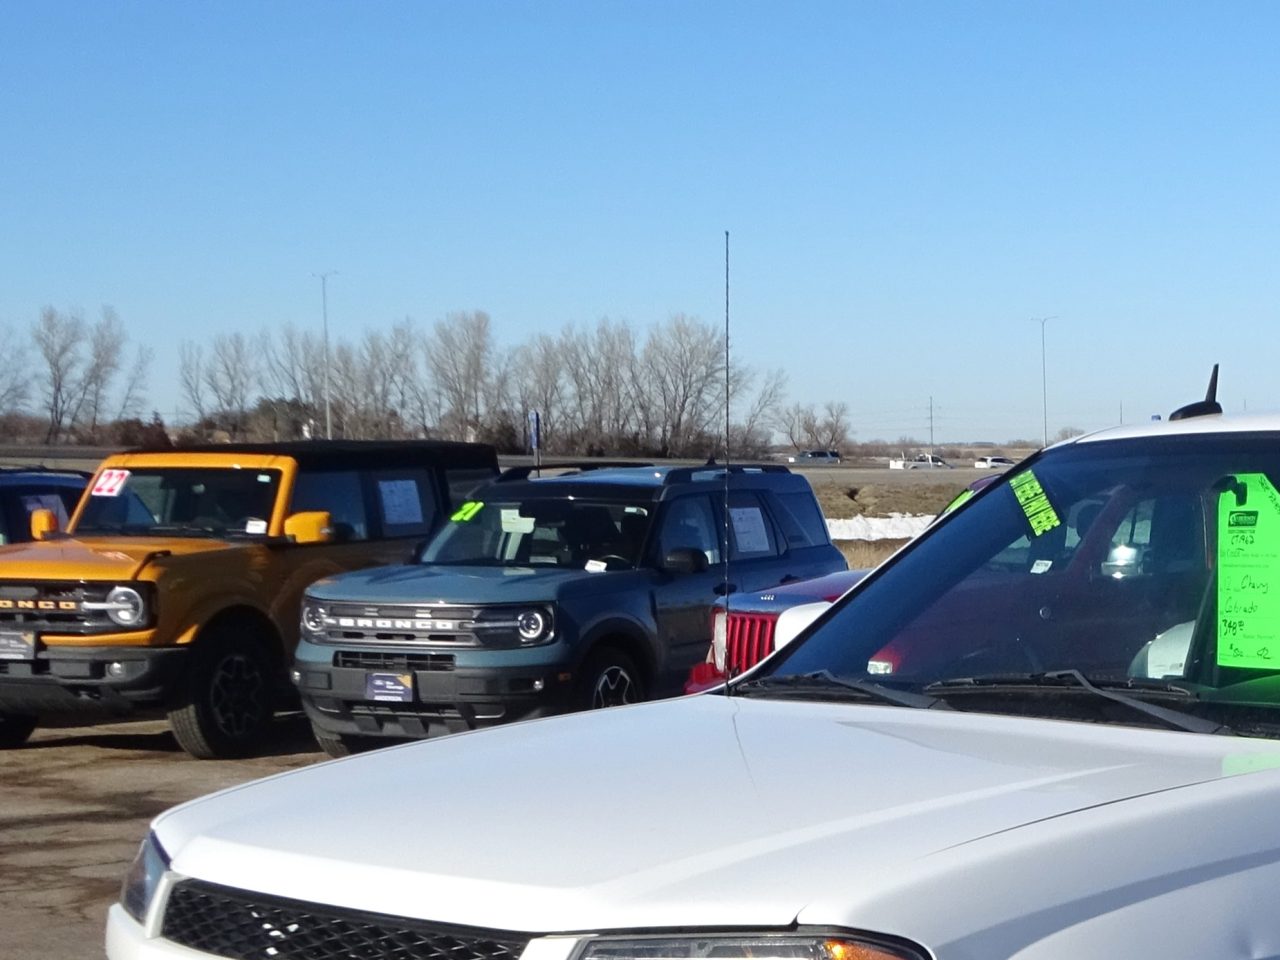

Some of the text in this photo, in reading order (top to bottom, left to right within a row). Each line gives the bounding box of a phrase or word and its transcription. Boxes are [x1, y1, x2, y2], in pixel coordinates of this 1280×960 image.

[93, 471, 128, 493] 22
[451, 502, 485, 521] 21
[1240, 574, 1269, 594] Chevy
[340, 618, 453, 629] BRONCO
